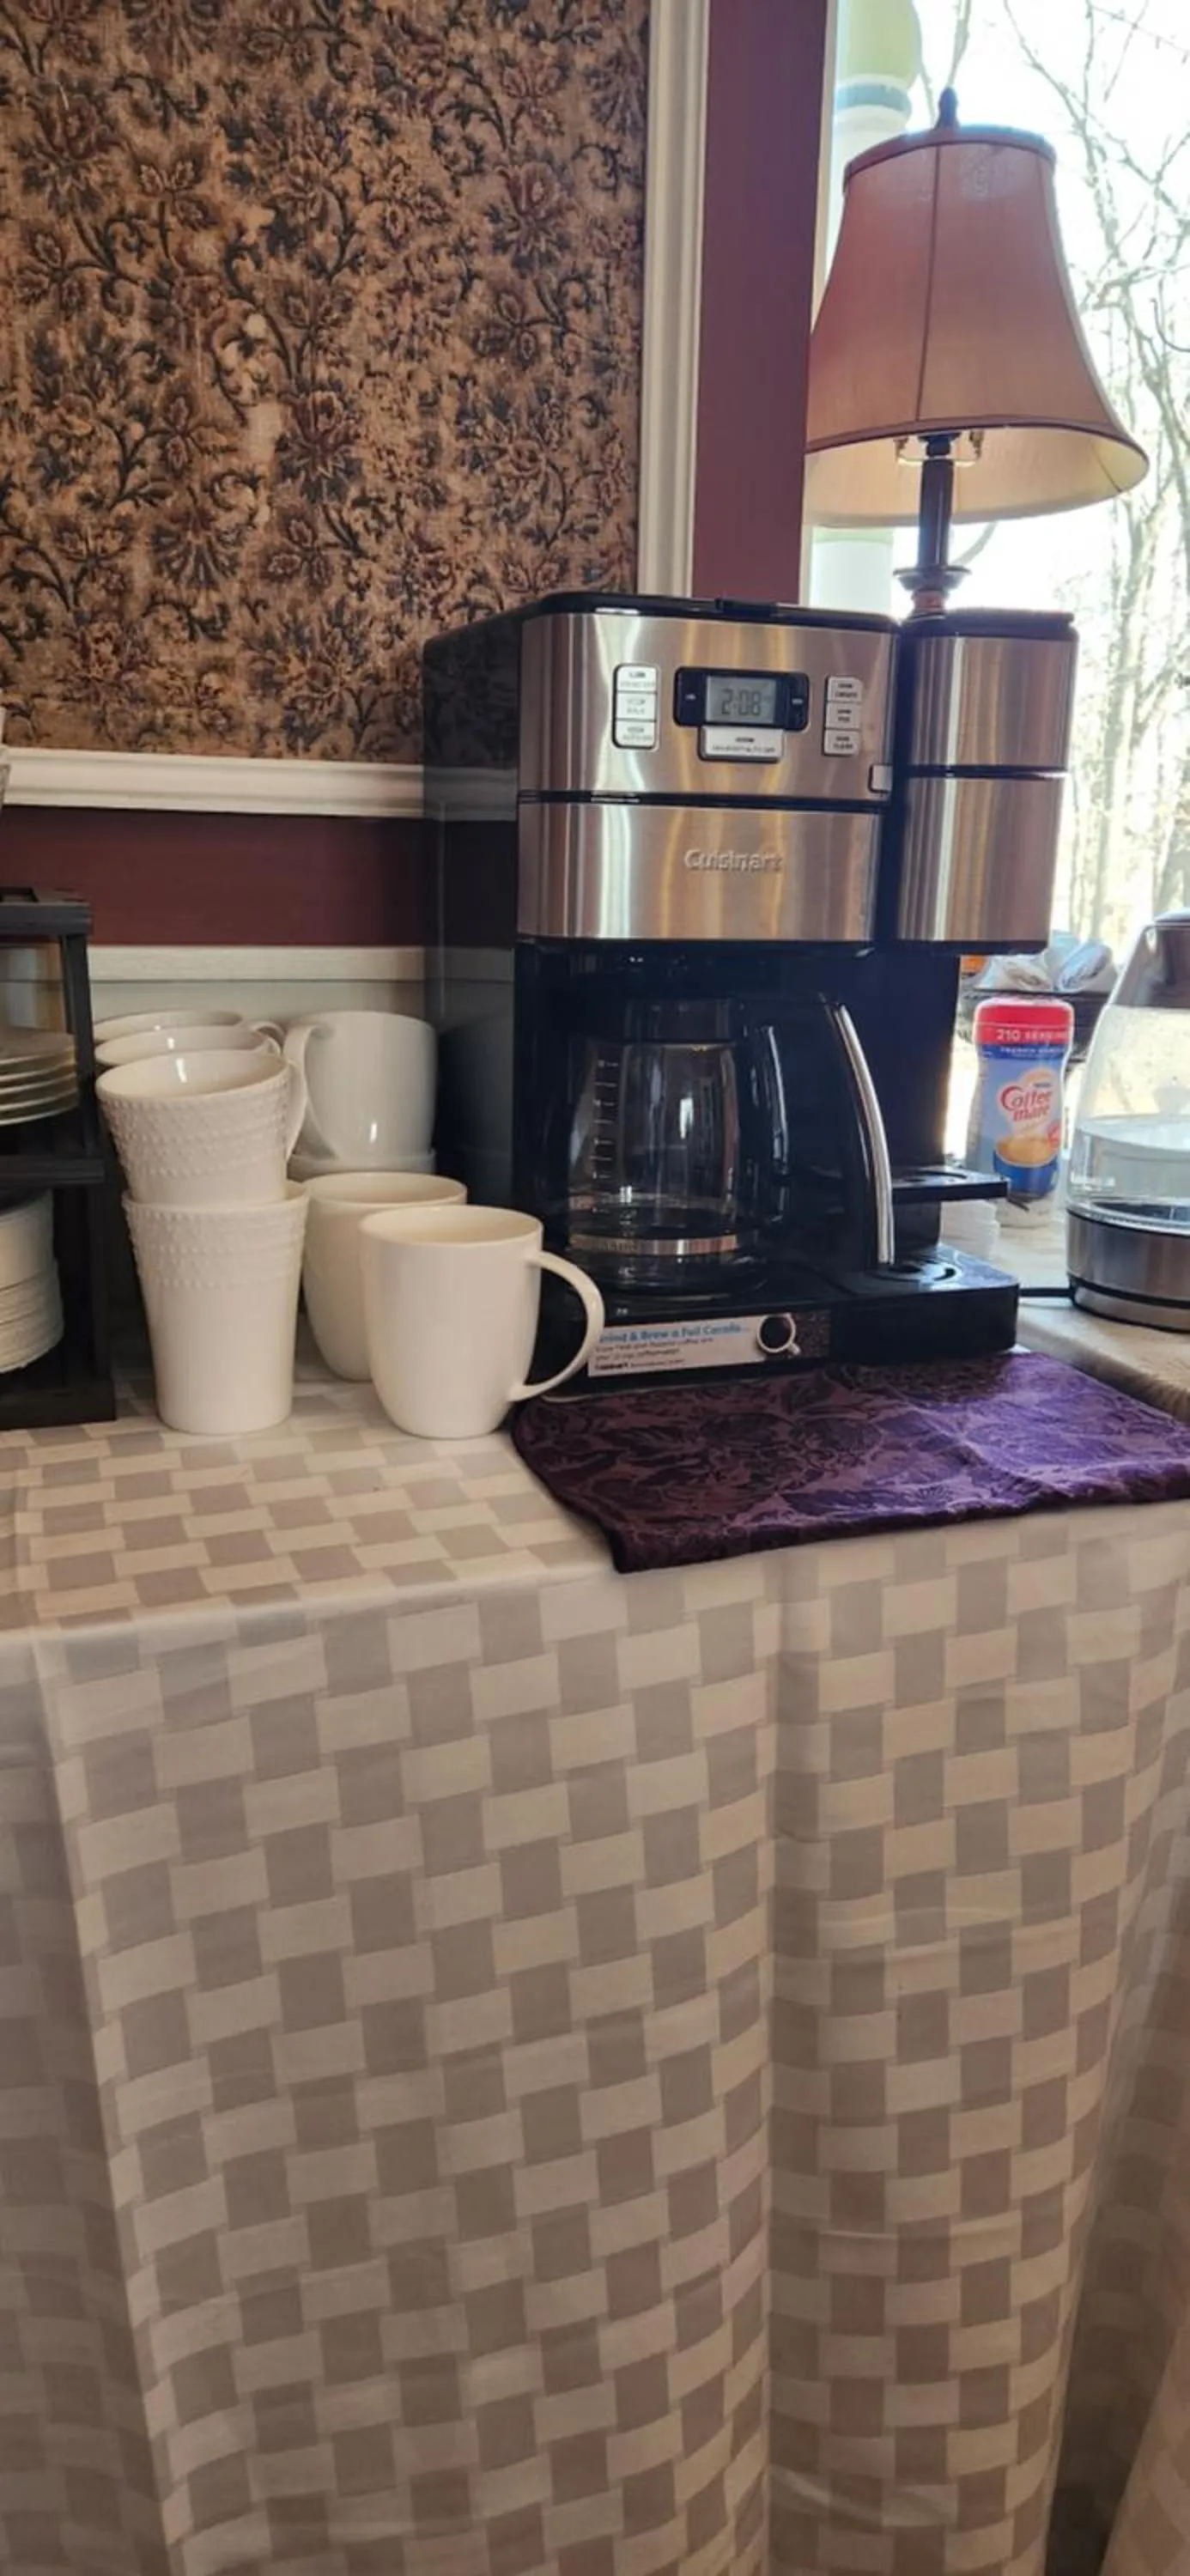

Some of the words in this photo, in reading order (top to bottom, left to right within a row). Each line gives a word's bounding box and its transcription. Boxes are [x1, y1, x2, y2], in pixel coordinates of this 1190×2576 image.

[721, 688, 762, 717] 2:08
[684, 848, 782, 872] Cuisinart
[997, 1029, 1021, 1042] 210
